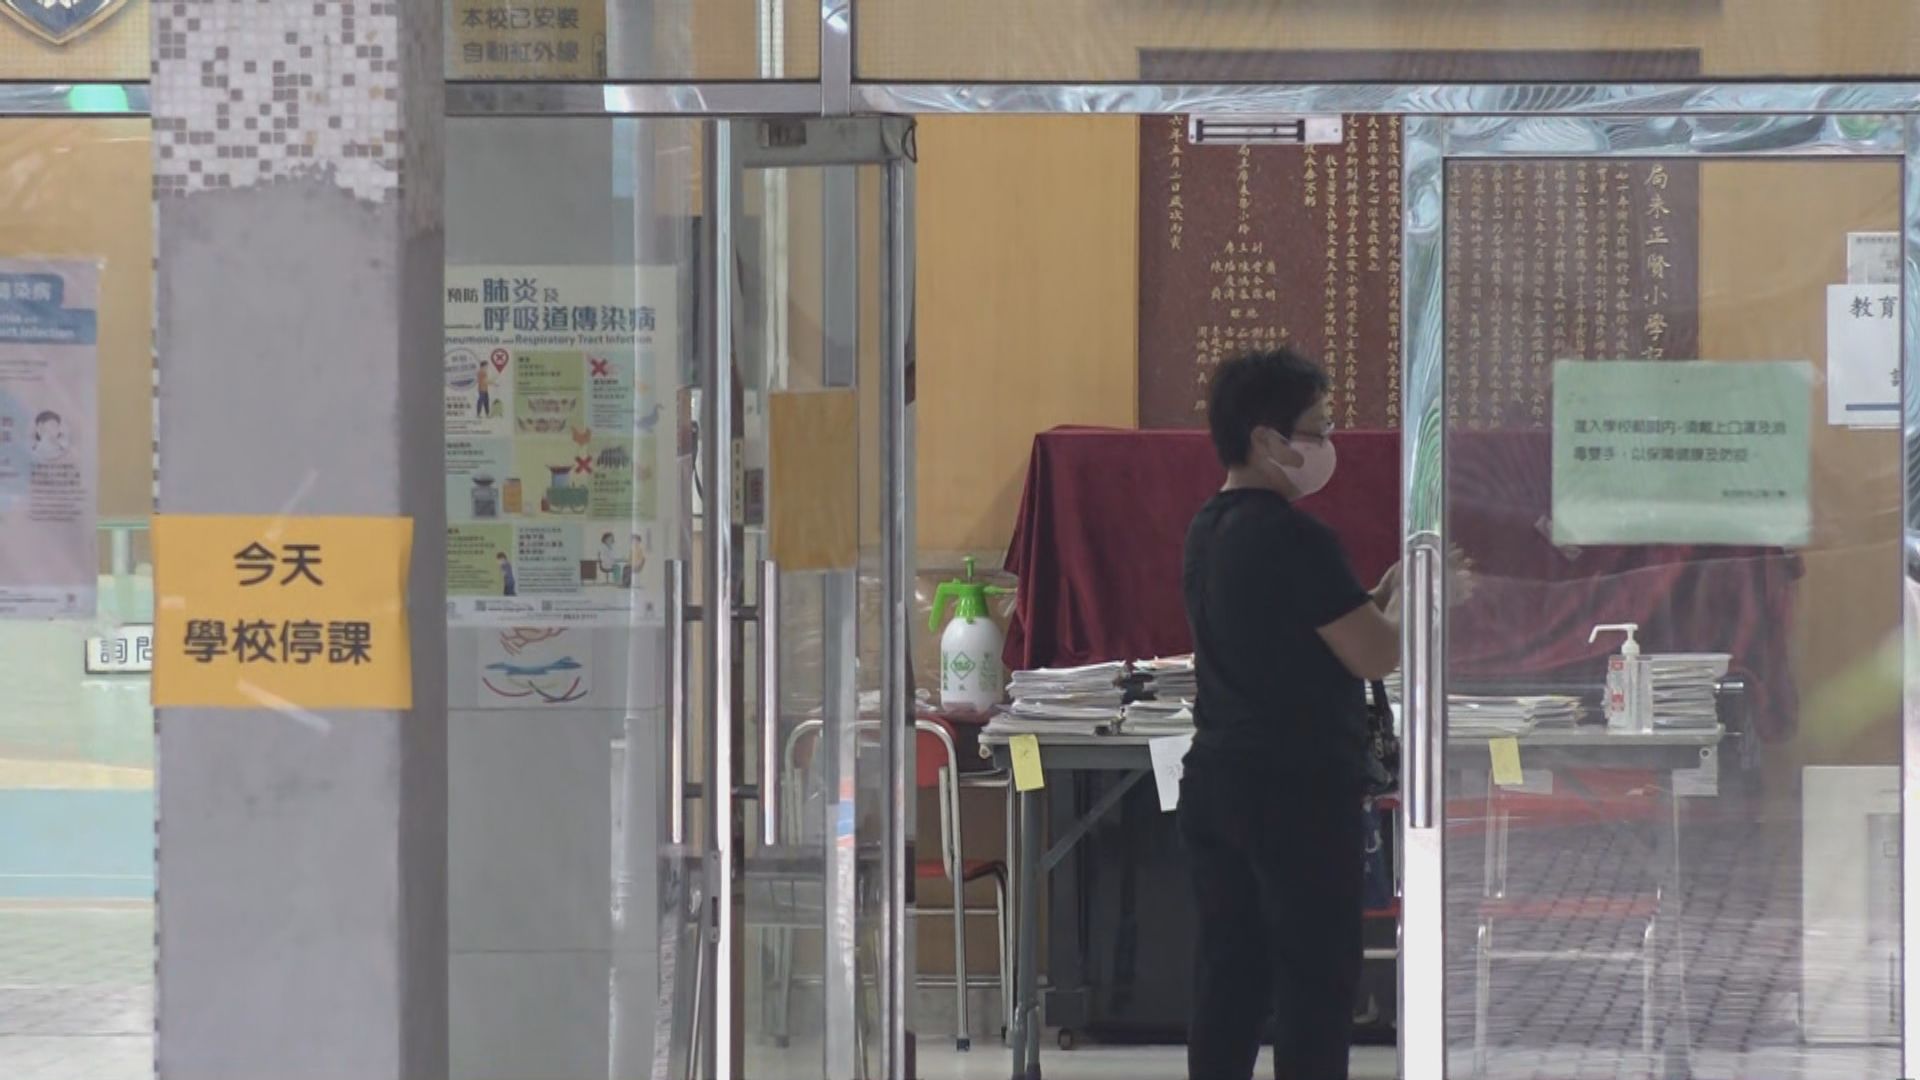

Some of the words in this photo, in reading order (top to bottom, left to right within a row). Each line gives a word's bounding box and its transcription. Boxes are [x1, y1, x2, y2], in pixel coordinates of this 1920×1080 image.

[462, 8, 579, 29] 本校已安裝
[463, 41, 579, 63] 自動紅外線
[483, 305, 656, 331] 呼吸道傳染病
[1849, 295, 1898, 319] 教育
[446, 335, 499, 346] neumonia
[515, 334, 575, 347] Respiratory
[578, 334, 603, 345] Tract
[233, 541, 324, 587] 今天
[183, 619, 373, 665] 學校停課
